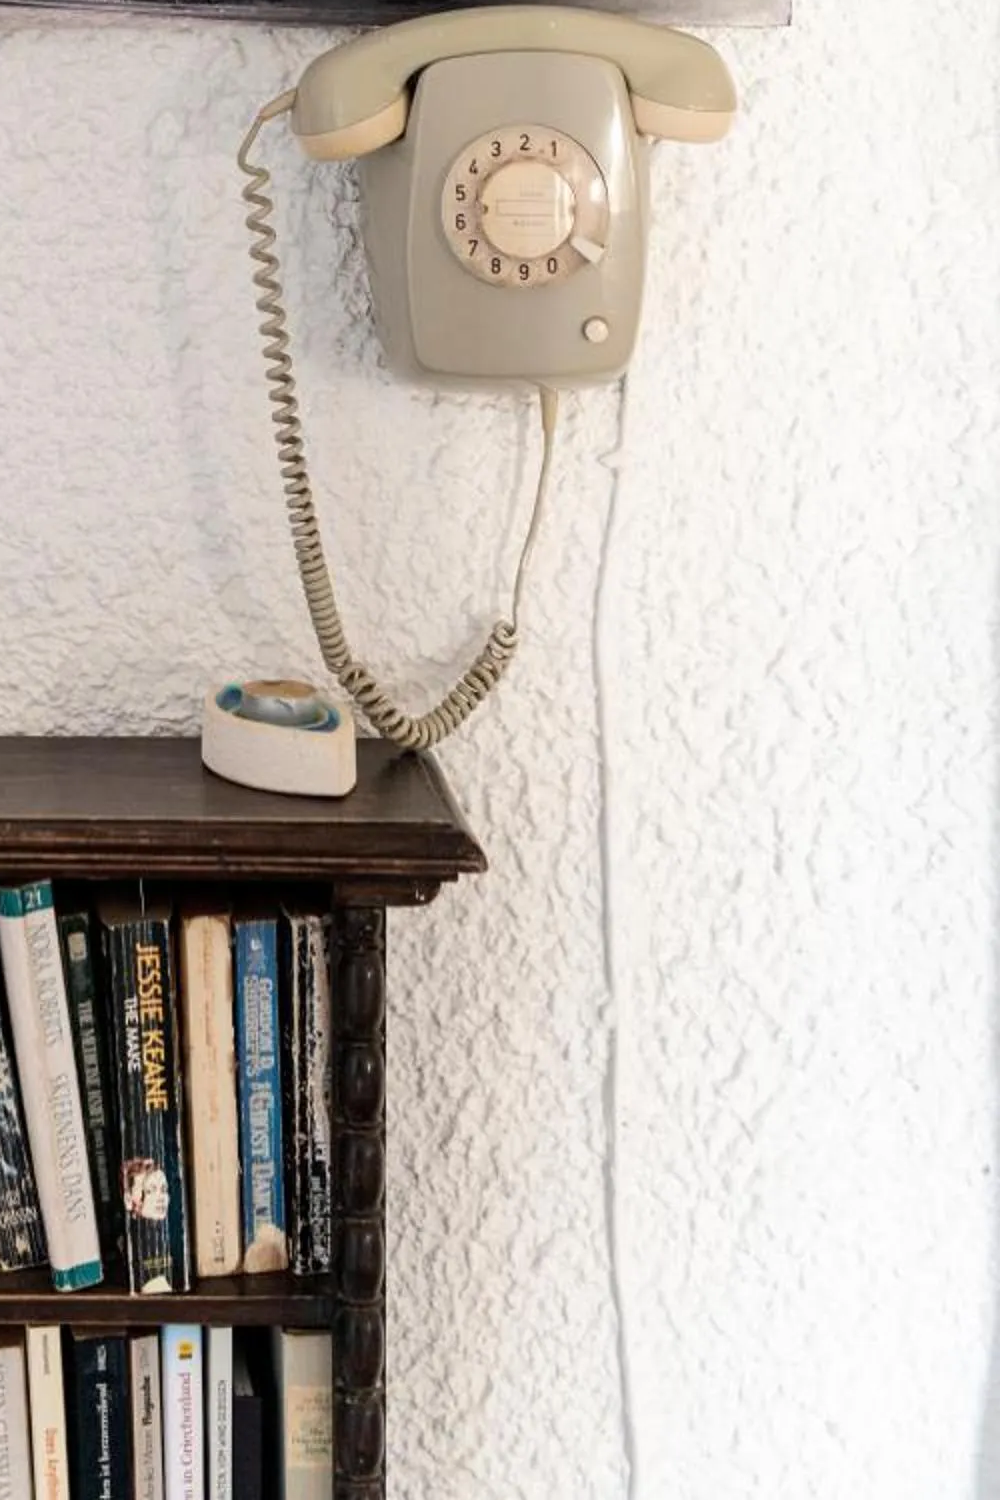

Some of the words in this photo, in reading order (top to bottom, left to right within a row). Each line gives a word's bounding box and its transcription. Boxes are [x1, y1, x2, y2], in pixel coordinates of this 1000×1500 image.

[491, 141, 501, 157] 3
[519, 134, 530, 151] 2
[551, 140, 557, 157] 1
[469, 159, 478, 174] 4
[455, 185, 465, 201] 5
[455, 214, 466, 230] 6
[468, 240, 478, 256] 7
[491, 258, 501, 274] 8
[519, 264, 529, 280] 9
[547, 258, 557, 274] 0
[25, 921, 54, 973] NORA
[134, 939, 165, 1024] JESSIE
[32, 976, 63, 1049] ROBERTS
[122, 995, 138, 1023] THE
[123, 1025, 141, 1074] MAKE
[138, 1027, 171, 1114] KEANE
[249, 1092, 275, 1157] GHOST
[60, 1173, 86, 1224] DANS
